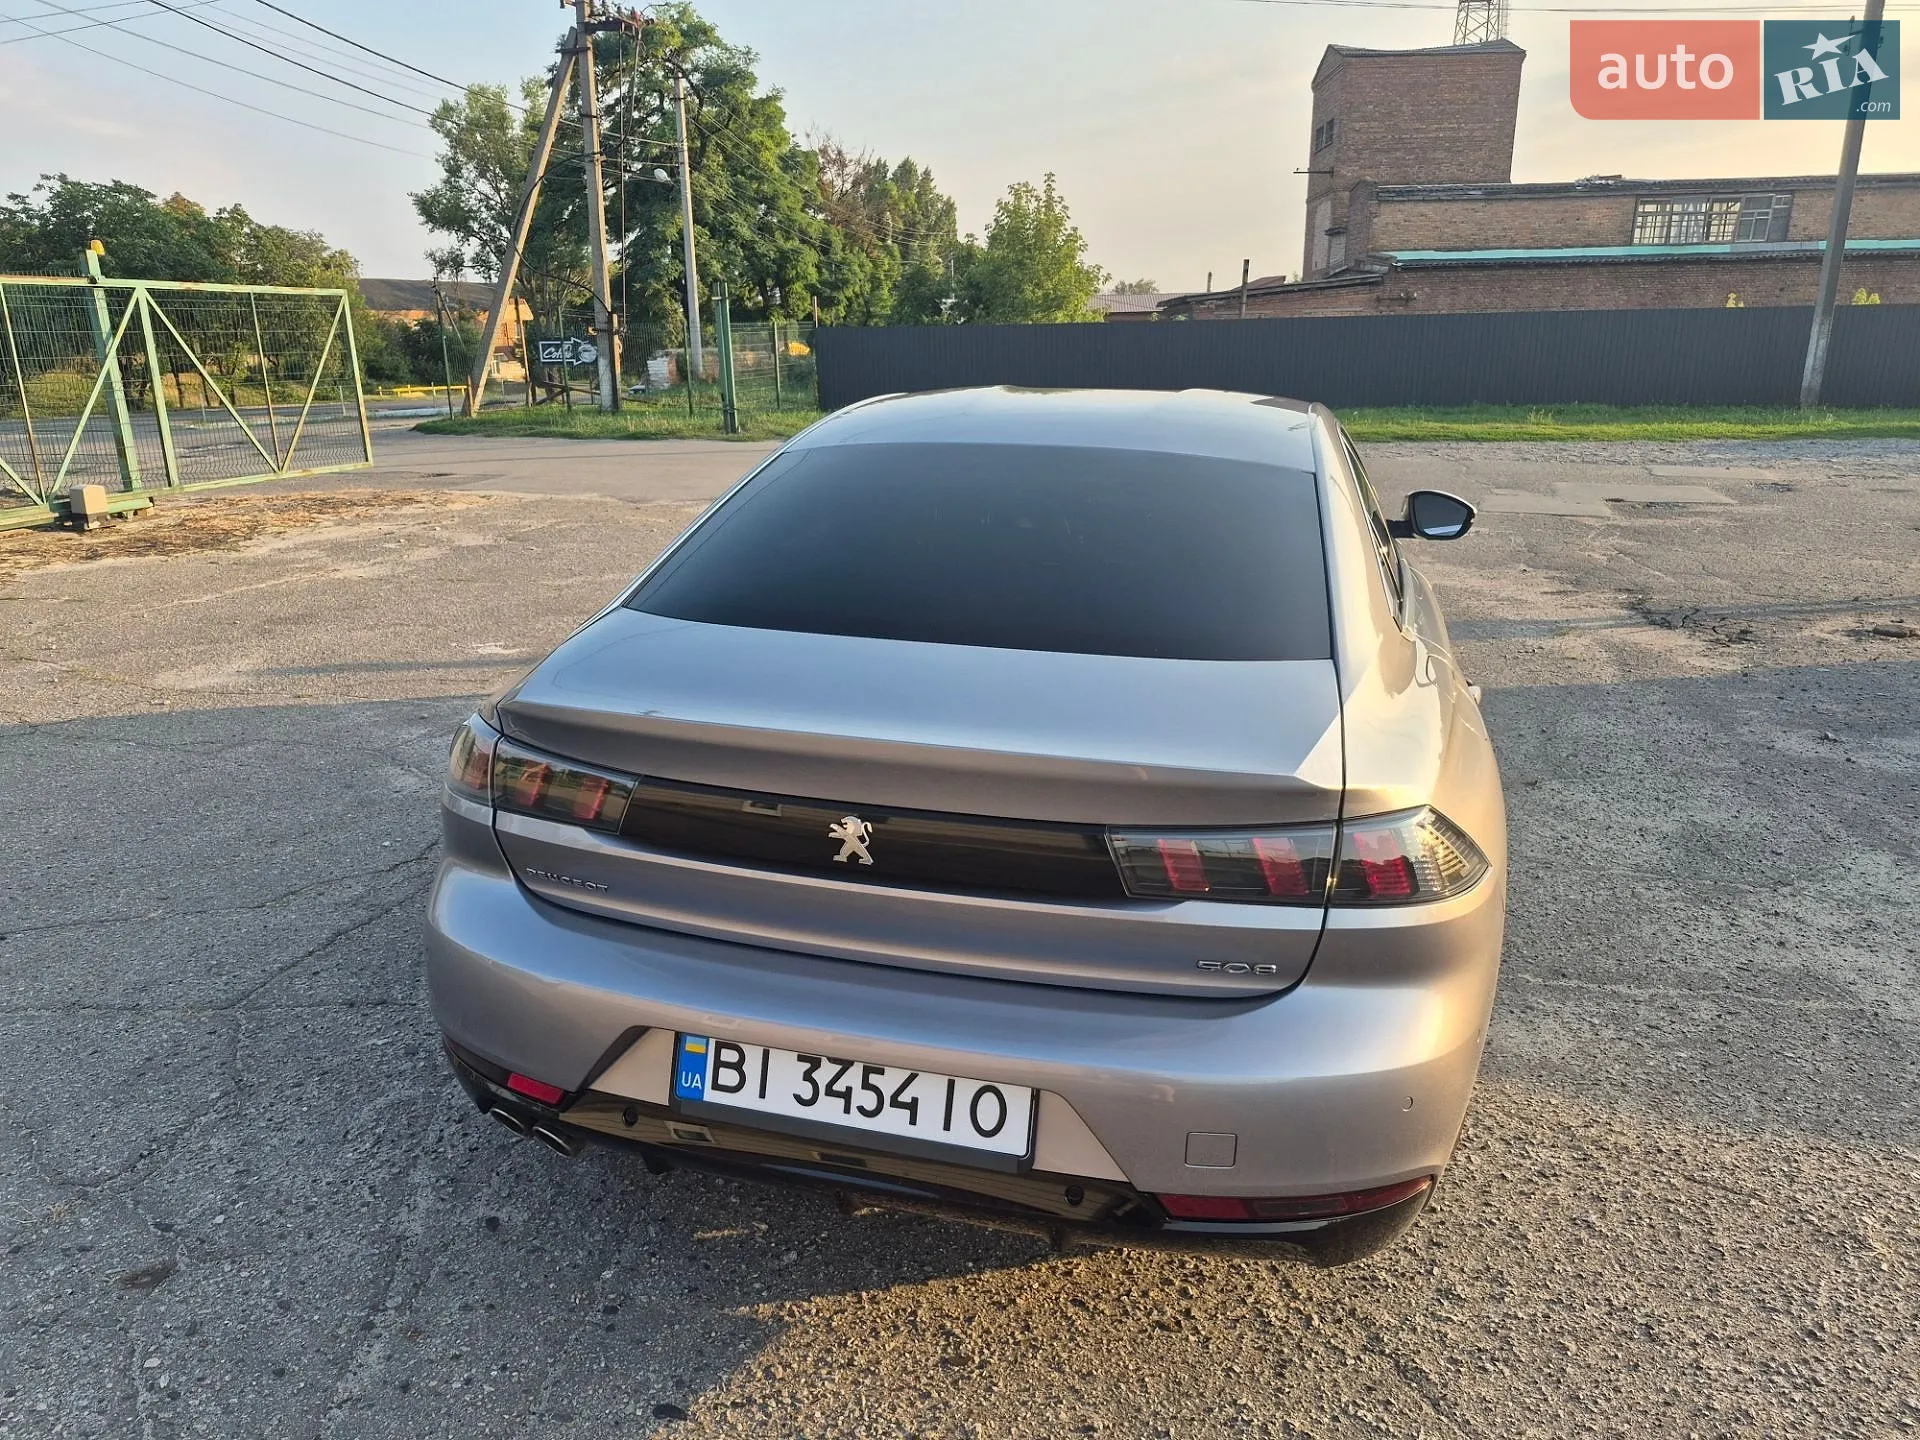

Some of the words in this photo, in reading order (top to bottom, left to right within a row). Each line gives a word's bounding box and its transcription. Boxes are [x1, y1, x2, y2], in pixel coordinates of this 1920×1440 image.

[1196, 960, 1277, 975] 508
[681, 1071, 702, 1089] UA
[710, 1040, 770, 1100] BI
[792, 1053, 920, 1126] 3454
[943, 1078, 1008, 1139] IO
